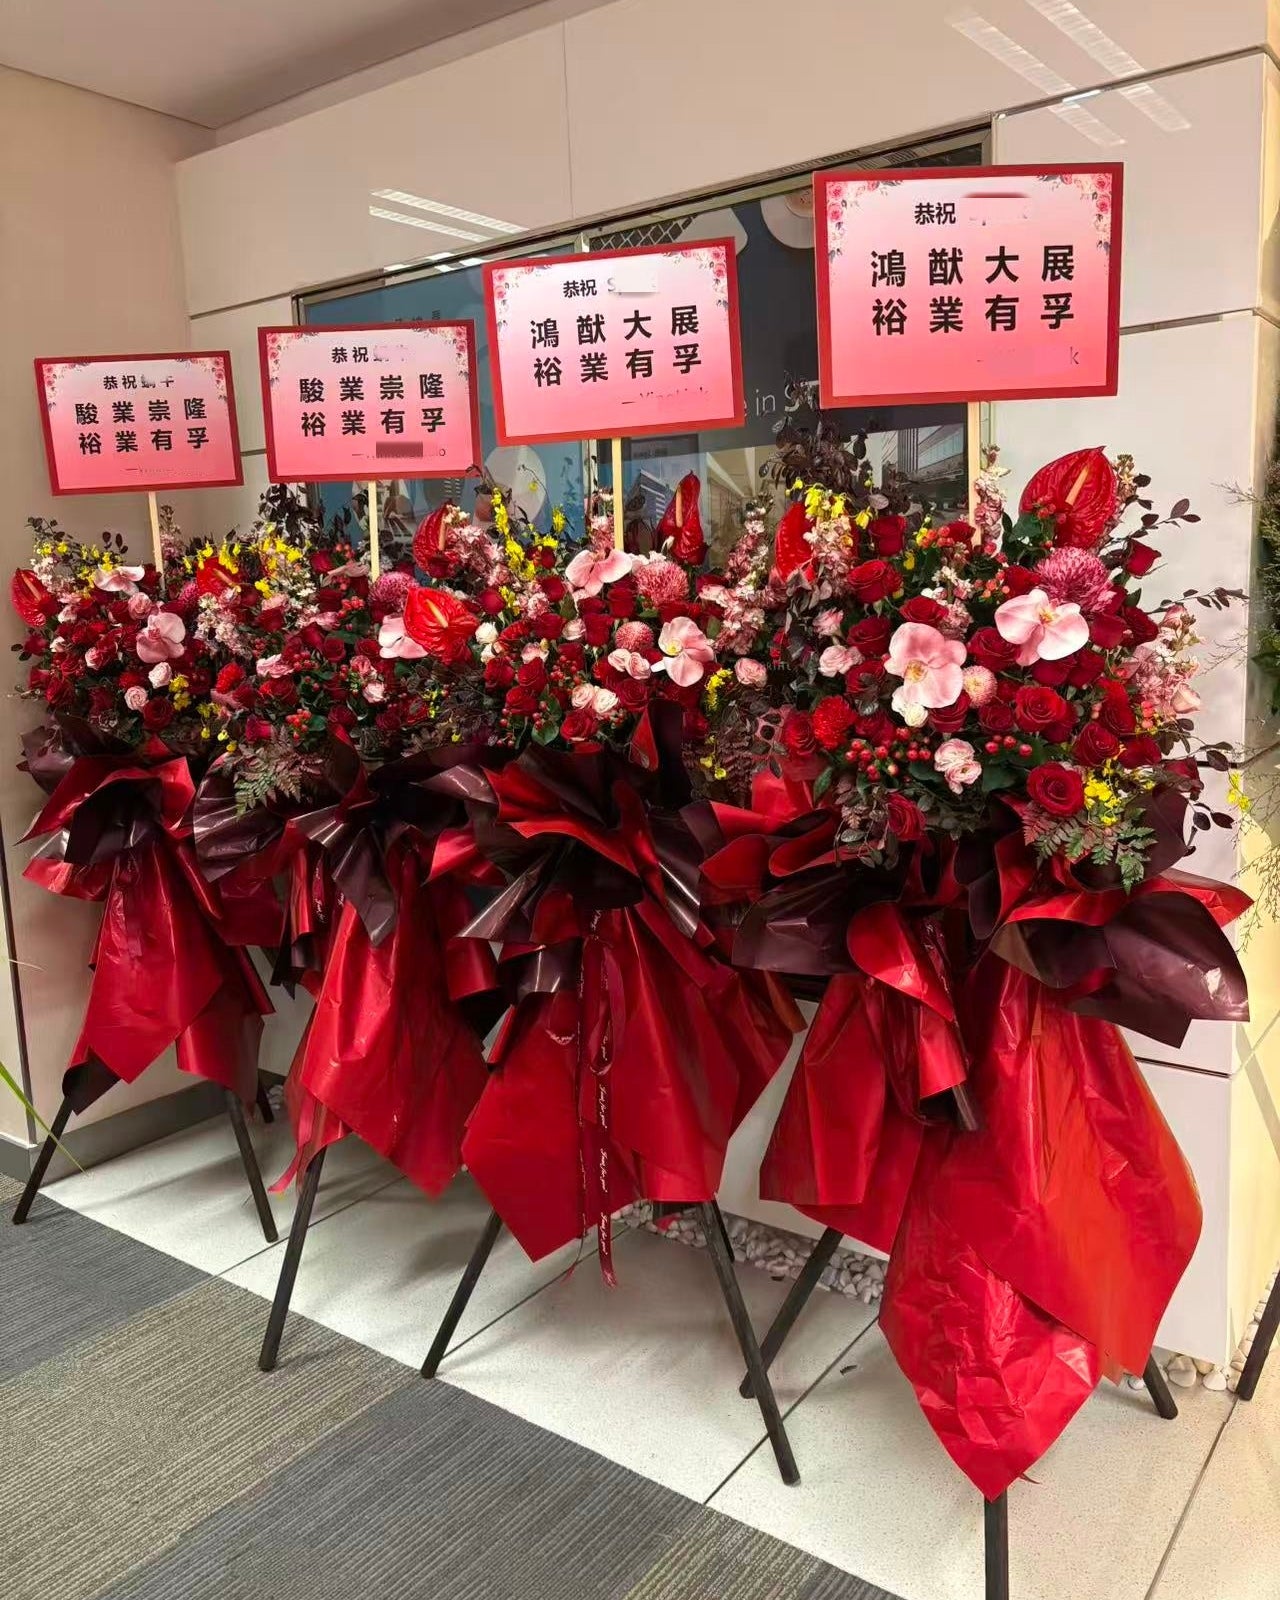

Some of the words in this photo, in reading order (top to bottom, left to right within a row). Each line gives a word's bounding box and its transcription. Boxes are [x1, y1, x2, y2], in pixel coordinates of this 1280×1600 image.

[914, 202, 957, 225] 恭祝
[870, 244, 1075, 288] 鴻猷大展
[562, 279, 598, 298] 恭祝
[871, 292, 1075, 336] 裕業有孚
[331, 346, 369, 363] 恭祝
[533, 343, 702, 387] 裕業有孚
[103, 375, 137, 390] 恭祝
[299, 372, 445, 404] 駿業崇隆
[75, 397, 208, 425] 駿業崇隆
[756, 389, 776, 416] in
[301, 407, 446, 437] 裕業有孚
[78, 427, 210, 455] 裕業有孚
